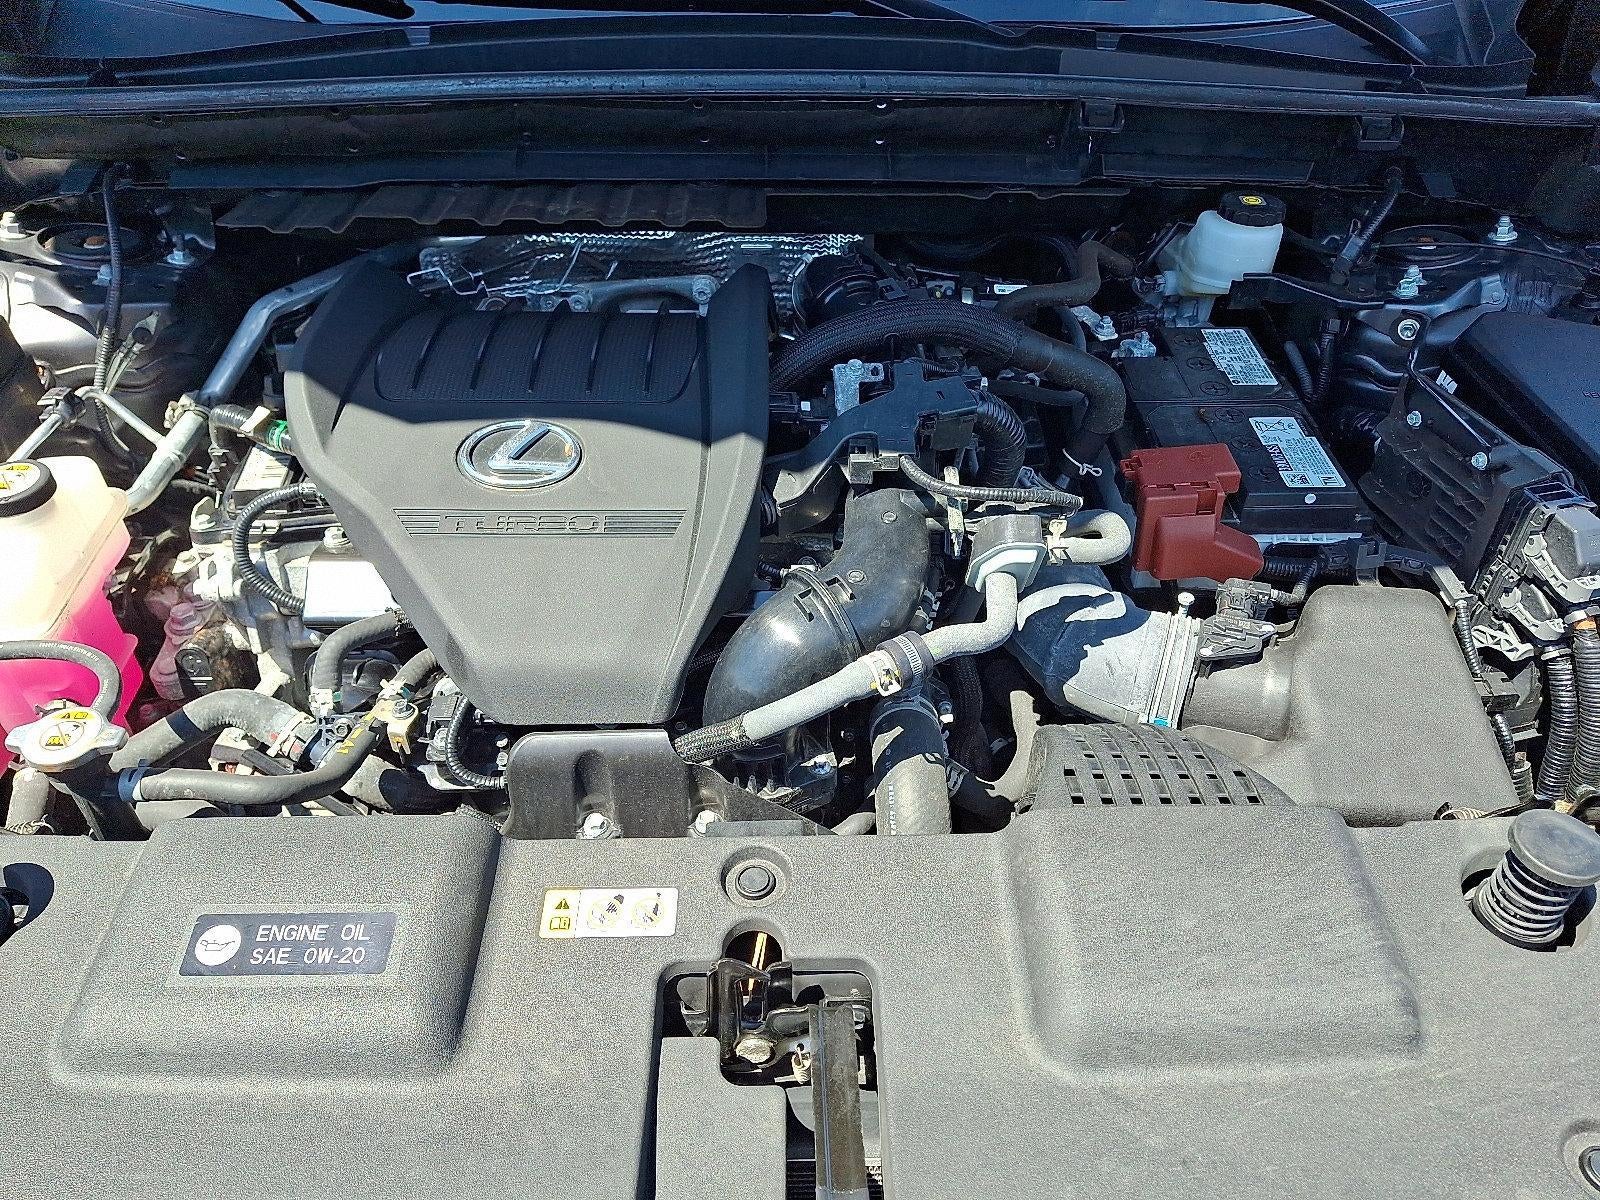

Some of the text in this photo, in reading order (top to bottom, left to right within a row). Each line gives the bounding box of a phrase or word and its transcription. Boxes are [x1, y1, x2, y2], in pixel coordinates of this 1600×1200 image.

[445, 514, 600, 532] TURBO
[256, 925, 371, 941] ENGINE OIL
[250, 949, 366, 964] SAE 0W-20
